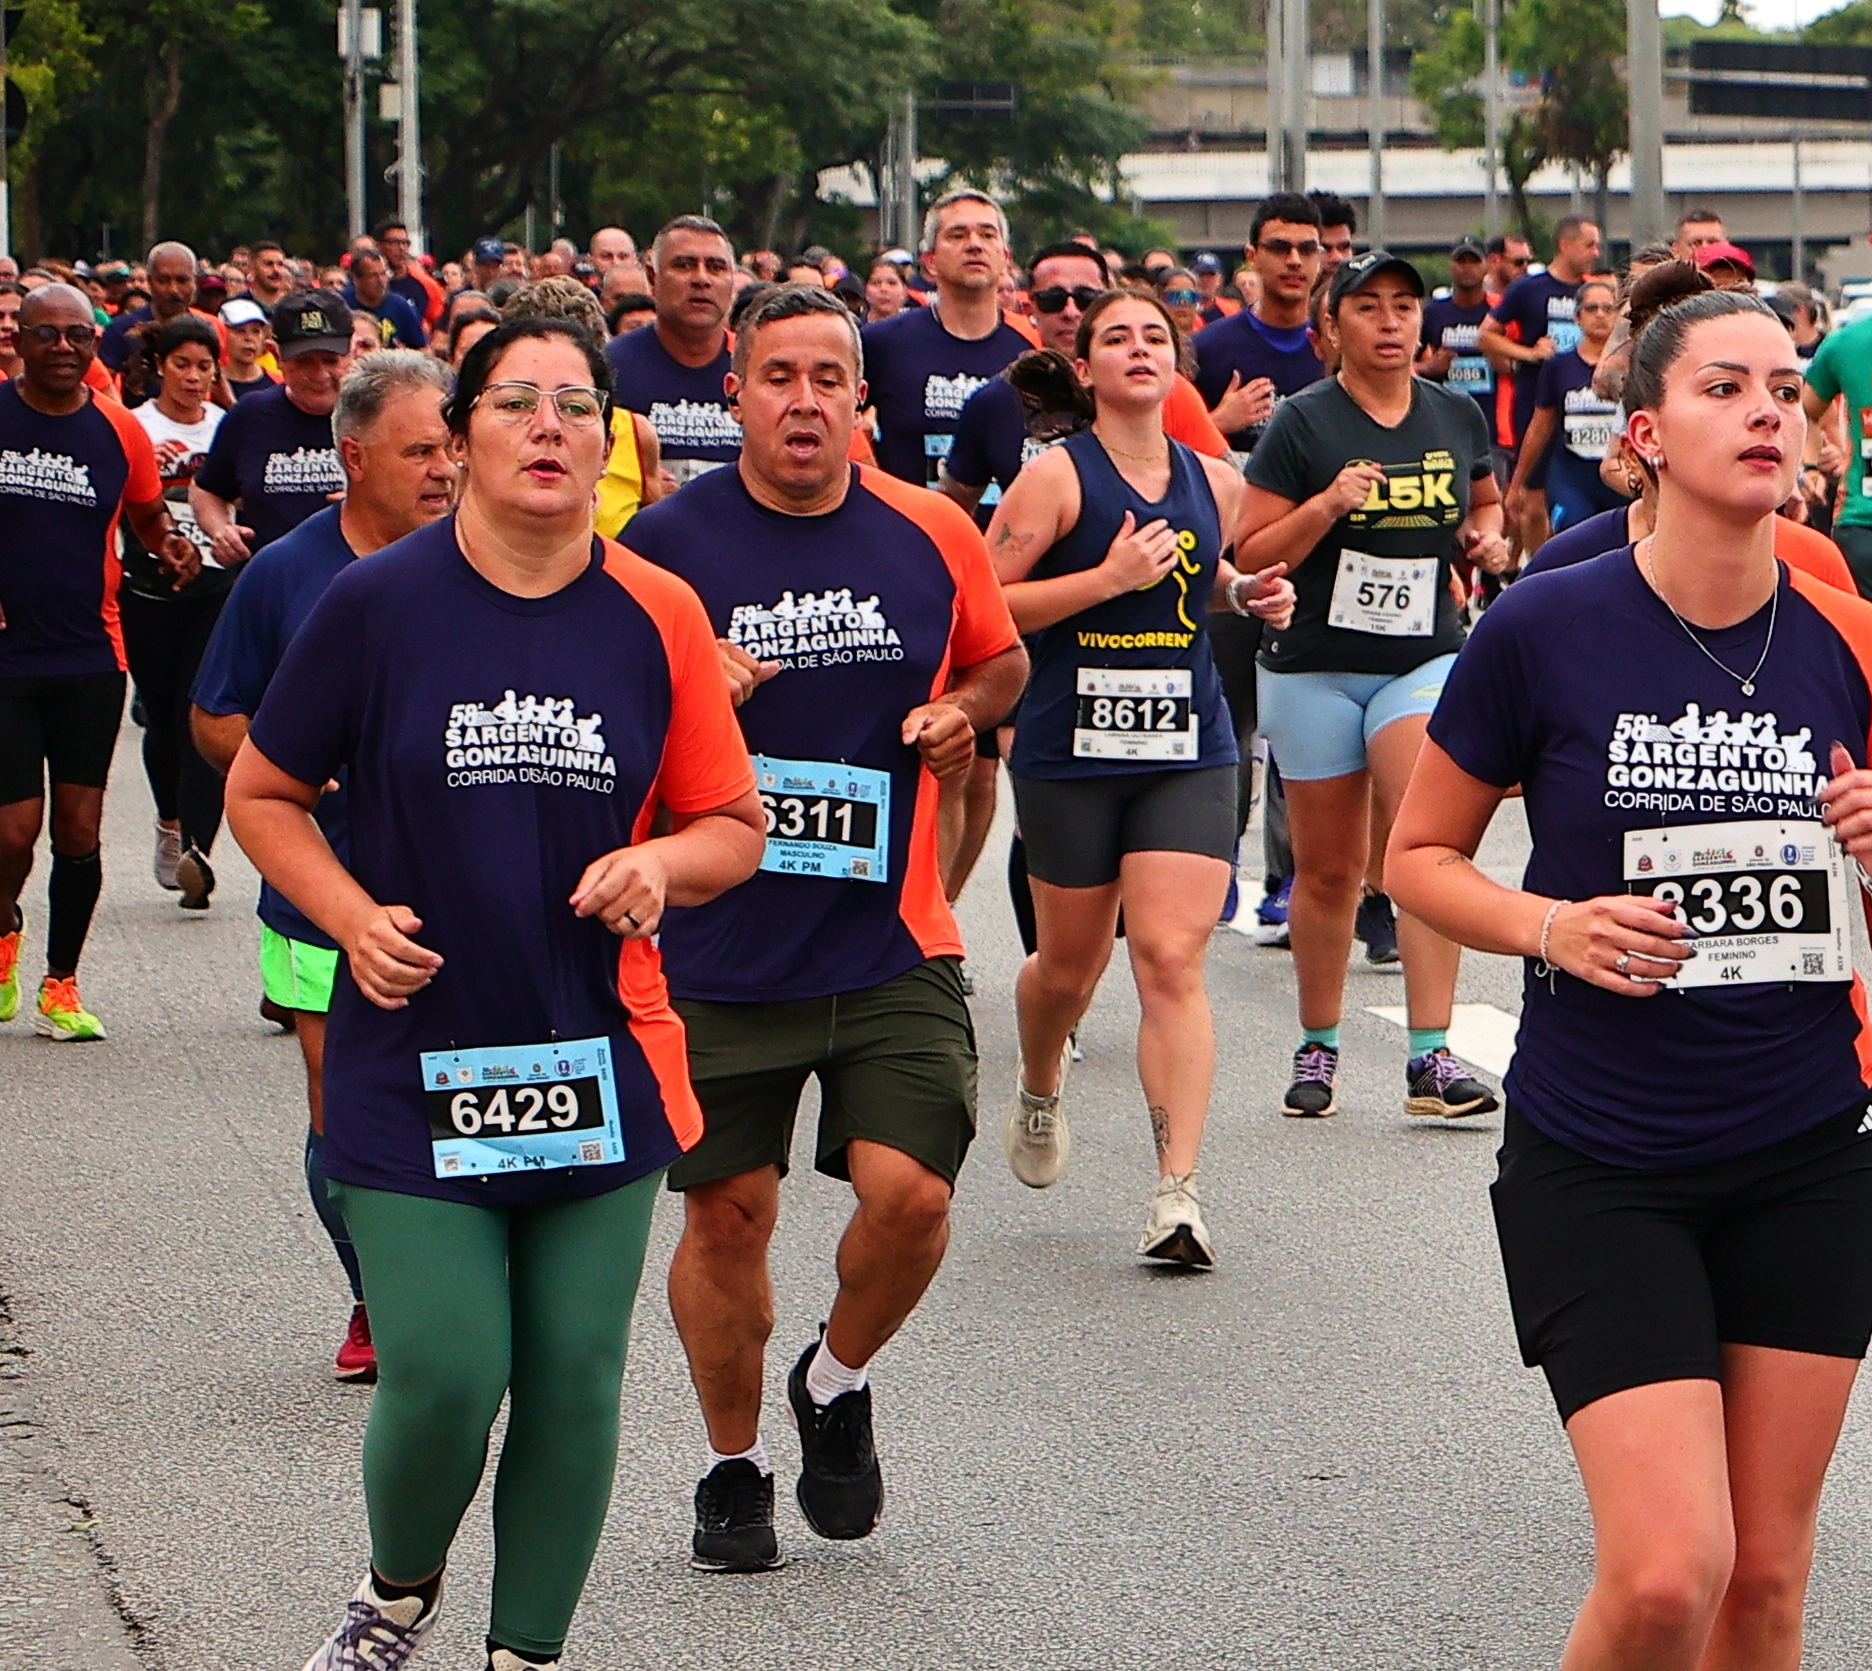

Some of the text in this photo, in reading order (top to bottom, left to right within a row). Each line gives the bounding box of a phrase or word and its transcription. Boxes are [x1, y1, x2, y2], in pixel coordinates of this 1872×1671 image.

[658, 425, 743, 438] ONZAGUINHA
[264, 472, 344, 484] GONZAGUIN
[265, 463, 341, 474] SARGENTO
[0, 485, 33, 496] ORRIDA
[1356, 581, 1410, 610] 576
[727, 613, 862, 644] SARGENTO
[798, 655, 819, 670] DE
[822, 649, 853, 666] SÃO
[857, 647, 904, 662] PAULO
[1092, 698, 1177, 730] 8612
[445, 724, 580, 748] SARGENTO
[446, 745, 617, 776] GONZAGUINHA
[1126, 748, 1138, 756] 4K
[1608, 740, 1786, 771] SARGENTO
[447, 768, 517, 788] CORRIDA
[531, 767, 563, 786] SÃO
[566, 773, 615, 794] PAULO
[1607, 764, 1829, 797] GONZAGUINHA
[1604, 790, 1695, 811] CORRIDA
[1700, 796, 1727, 813] DE
[1731, 793, 1774, 814] SÃO
[759, 794, 853, 842] 6311
[768, 839, 811, 850] FERNANDO
[779, 849, 825, 859] MASCULINO
[779, 860, 821, 872] 4K PM
[1652, 874, 1804, 934] 8336
[1736, 935, 1779, 947] BORGES
[1707, 950, 1756, 962] FEMININO
[1720, 966, 1743, 981] 4K
[450, 1084, 579, 1135] 6429
[498, 1157, 517, 1169] 4K
